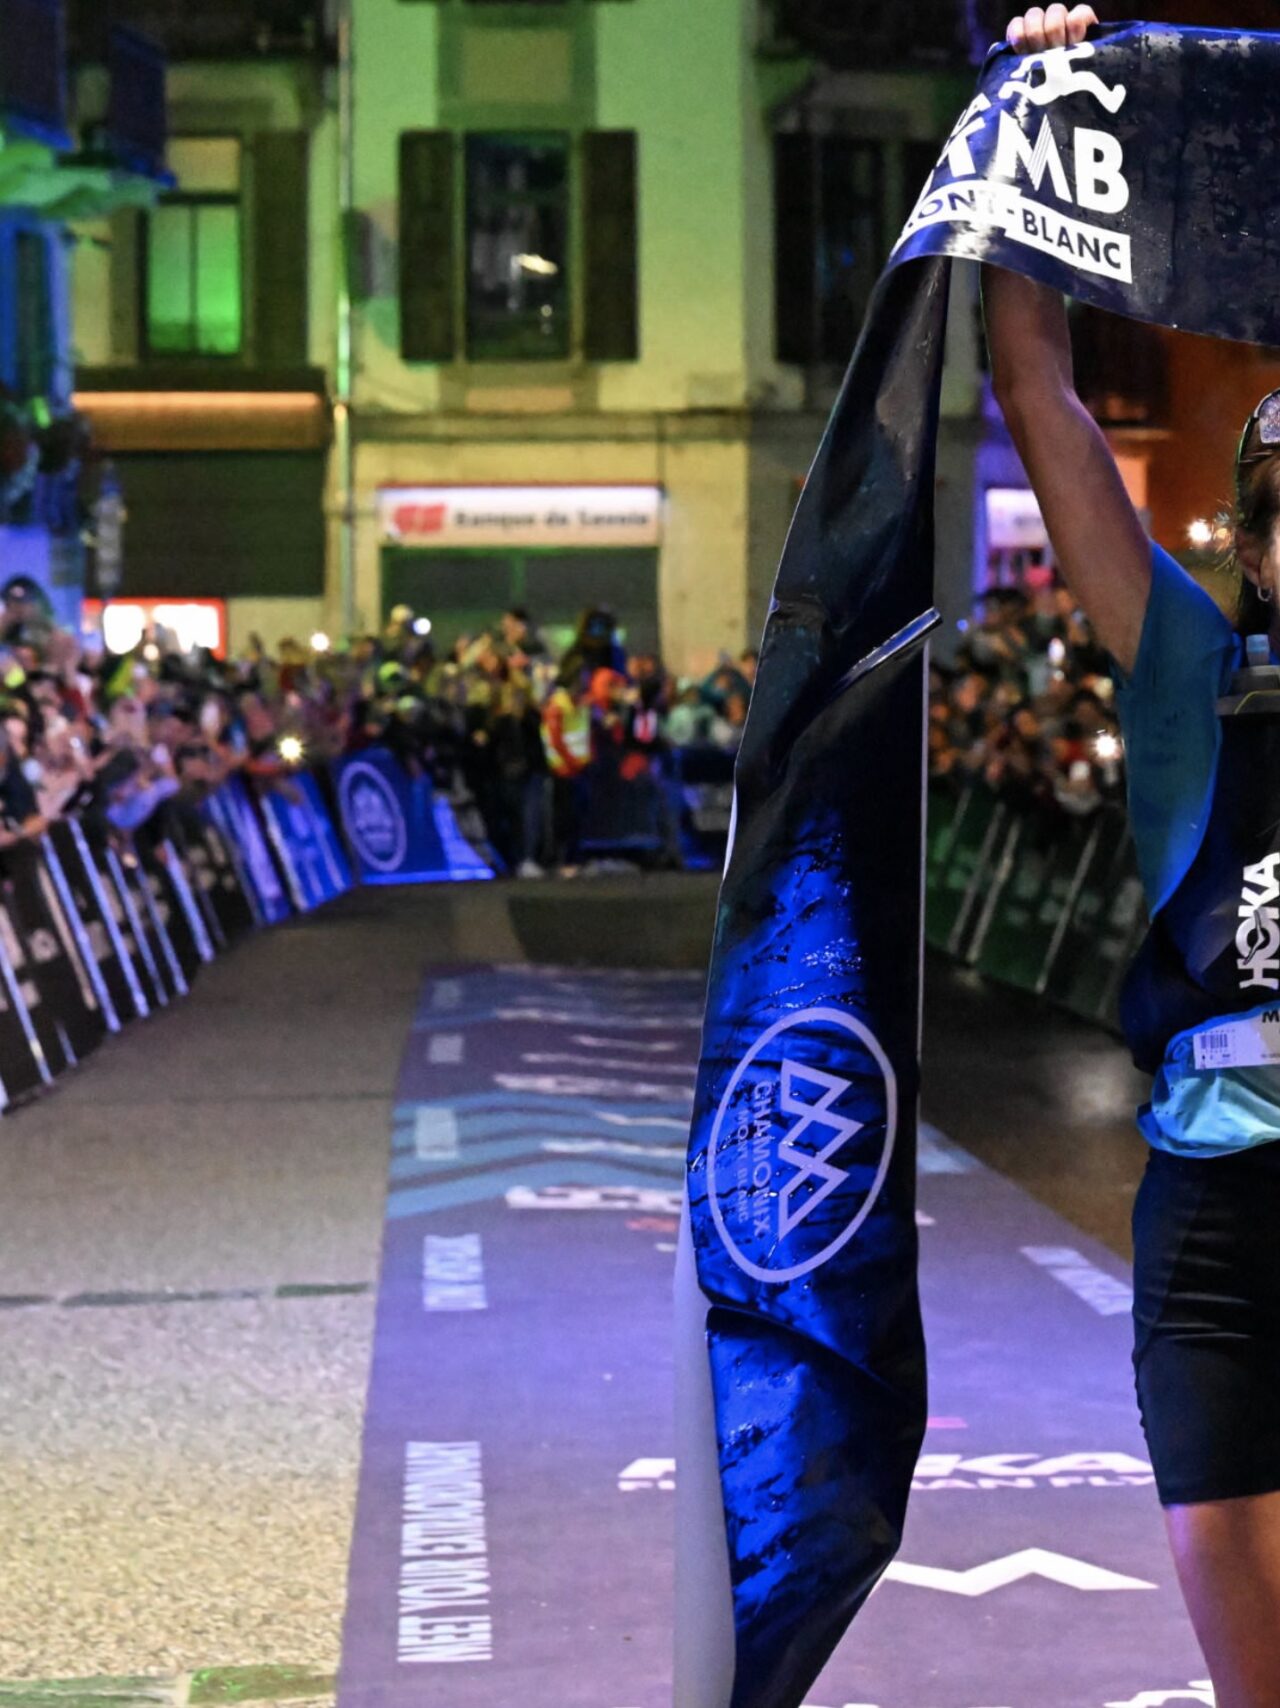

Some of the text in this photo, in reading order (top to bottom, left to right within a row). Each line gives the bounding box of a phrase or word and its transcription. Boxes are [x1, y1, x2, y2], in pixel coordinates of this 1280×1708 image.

[918, 92, 1129, 214] TMB
[908, 189, 1122, 270] ONT-BLANC
[1235, 852, 1280, 990] HOKA
[752, 1079, 773, 1237] CHAMONIX
[397, 1557, 491, 1613] YOUR
[397, 1614, 493, 1663] MEET
